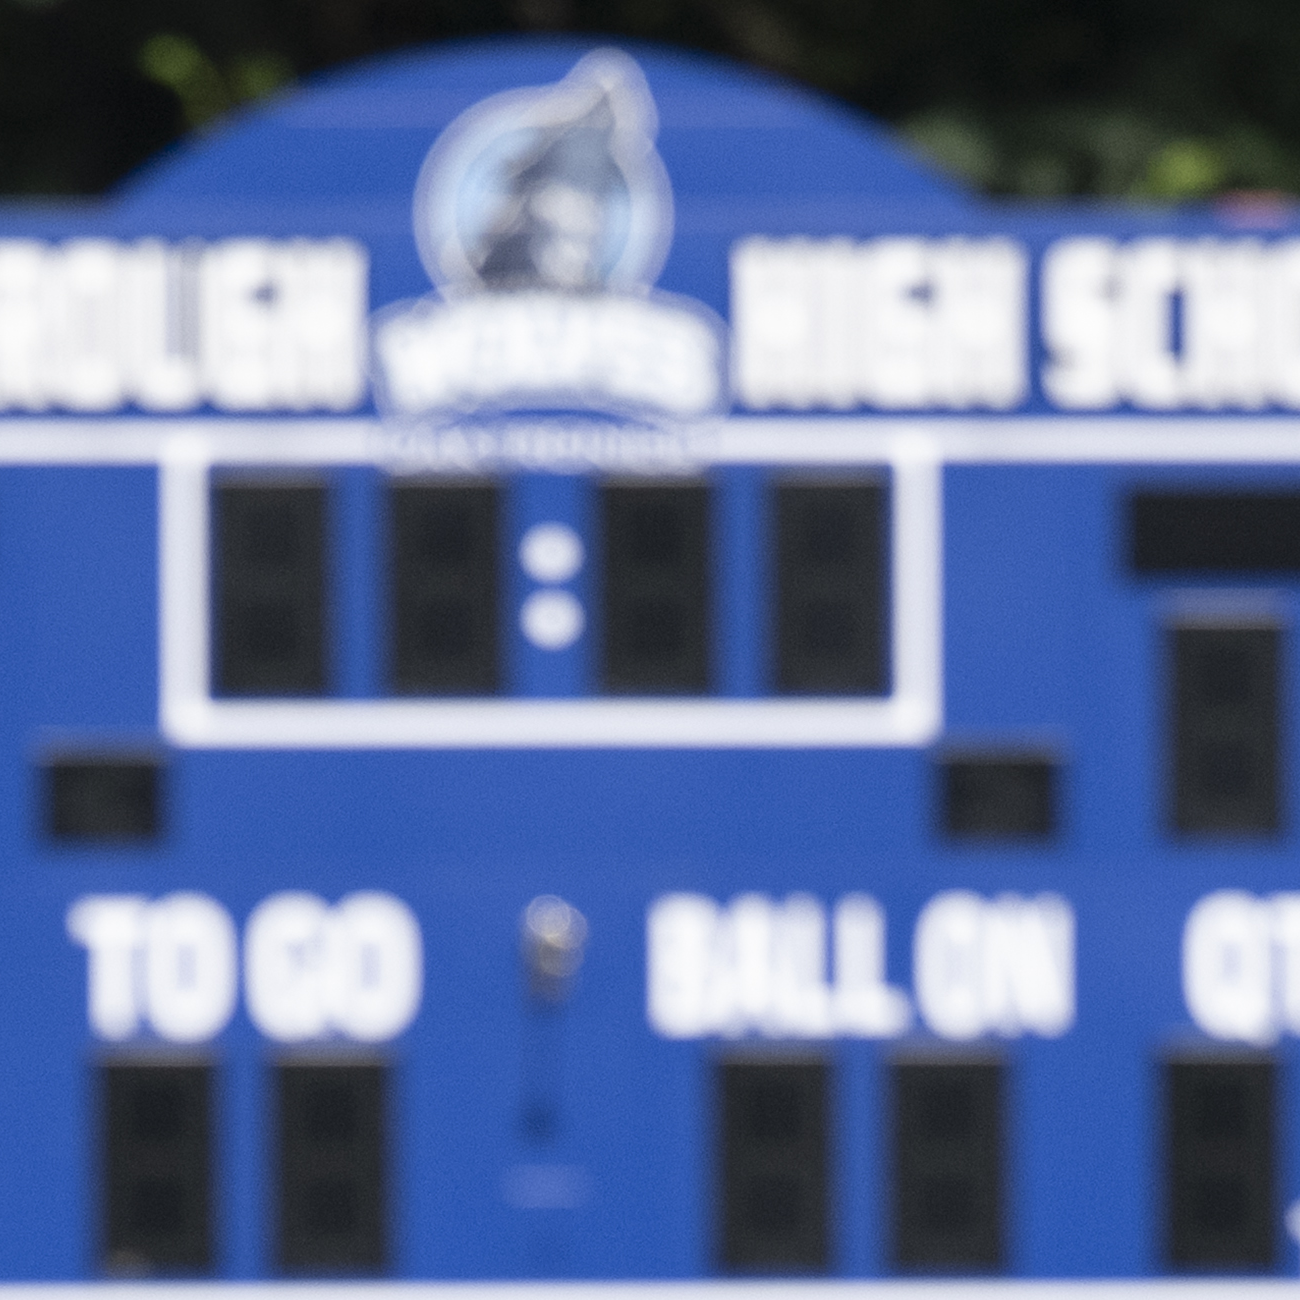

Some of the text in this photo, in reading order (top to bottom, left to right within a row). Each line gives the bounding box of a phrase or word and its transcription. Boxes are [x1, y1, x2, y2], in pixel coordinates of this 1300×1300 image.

[733, 241, 1027, 407] HIGH
[68, 891, 423, 1042] TO GO
[646, 891, 1075, 1040] BALL ON
